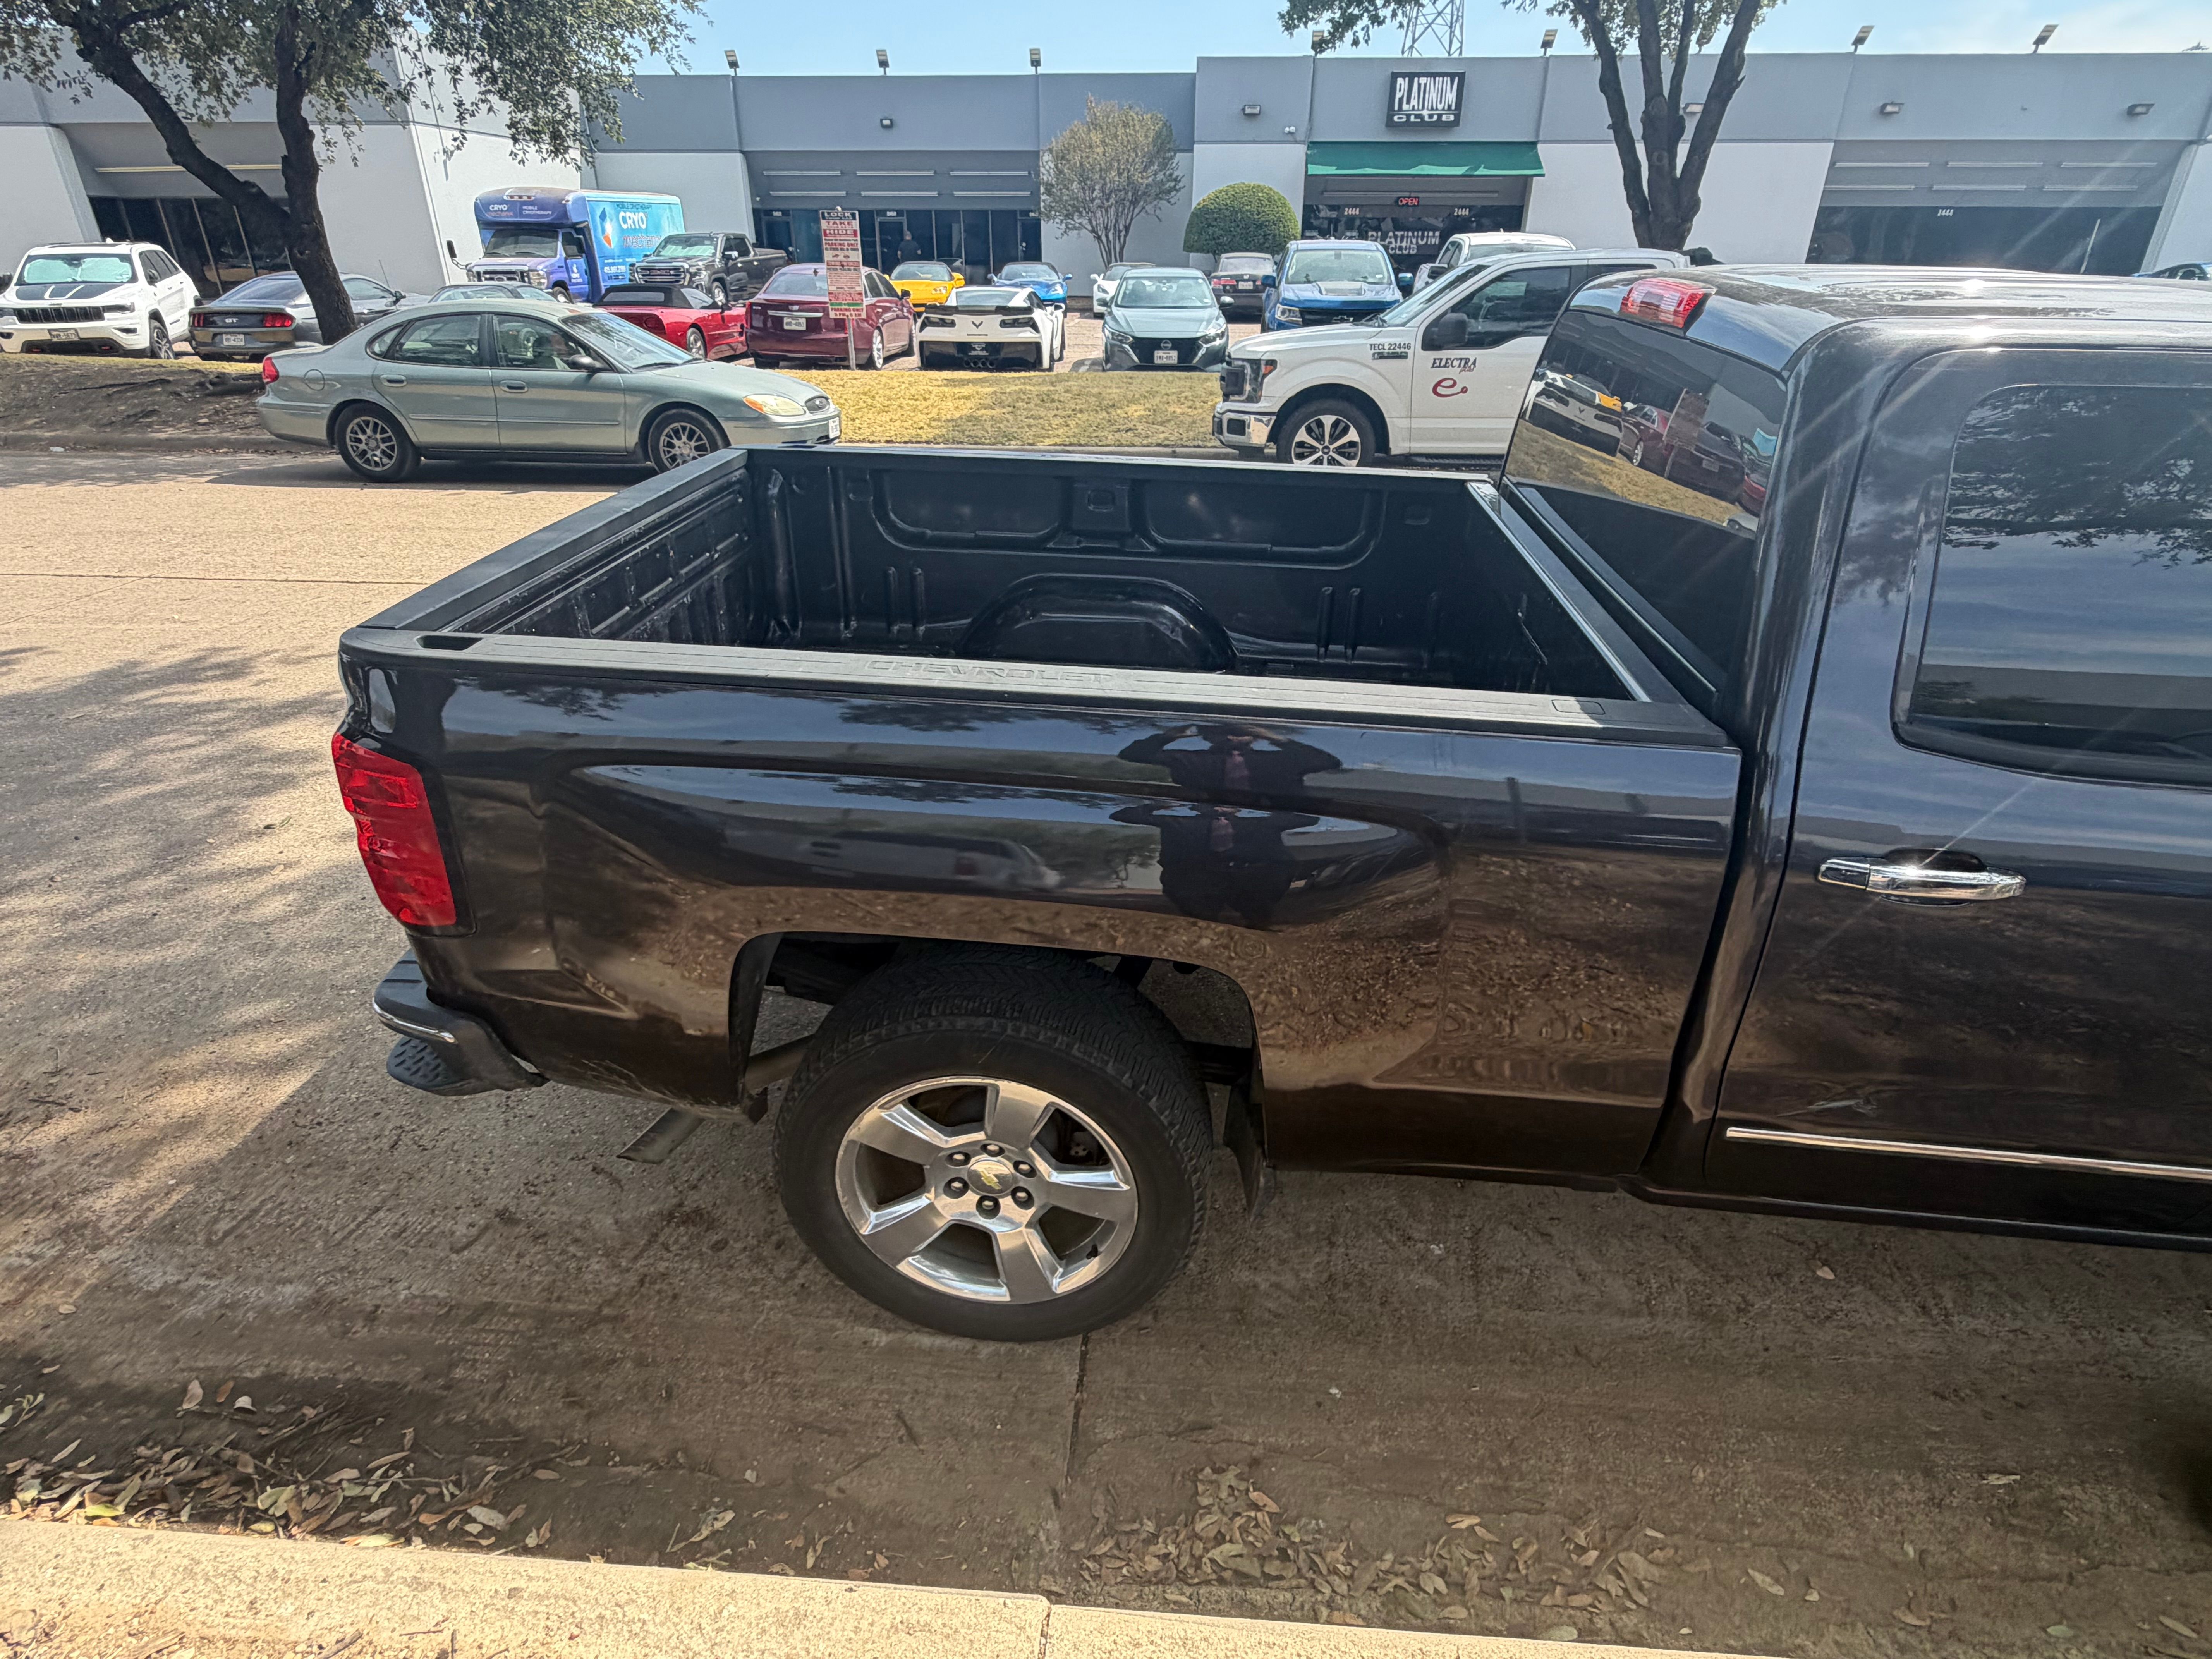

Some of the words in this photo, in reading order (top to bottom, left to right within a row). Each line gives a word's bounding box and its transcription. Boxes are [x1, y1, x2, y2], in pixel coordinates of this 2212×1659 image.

[1395, 77, 1458, 111] PLATINUM
[619, 211, 647, 229] CRYO
[1368, 231, 1440, 245] PLATINUM
[1389, 244, 1417, 254] CLUB
[1431, 357, 1477, 368] ELECTRA
[865, 659, 1113, 683] CHEVROLET
